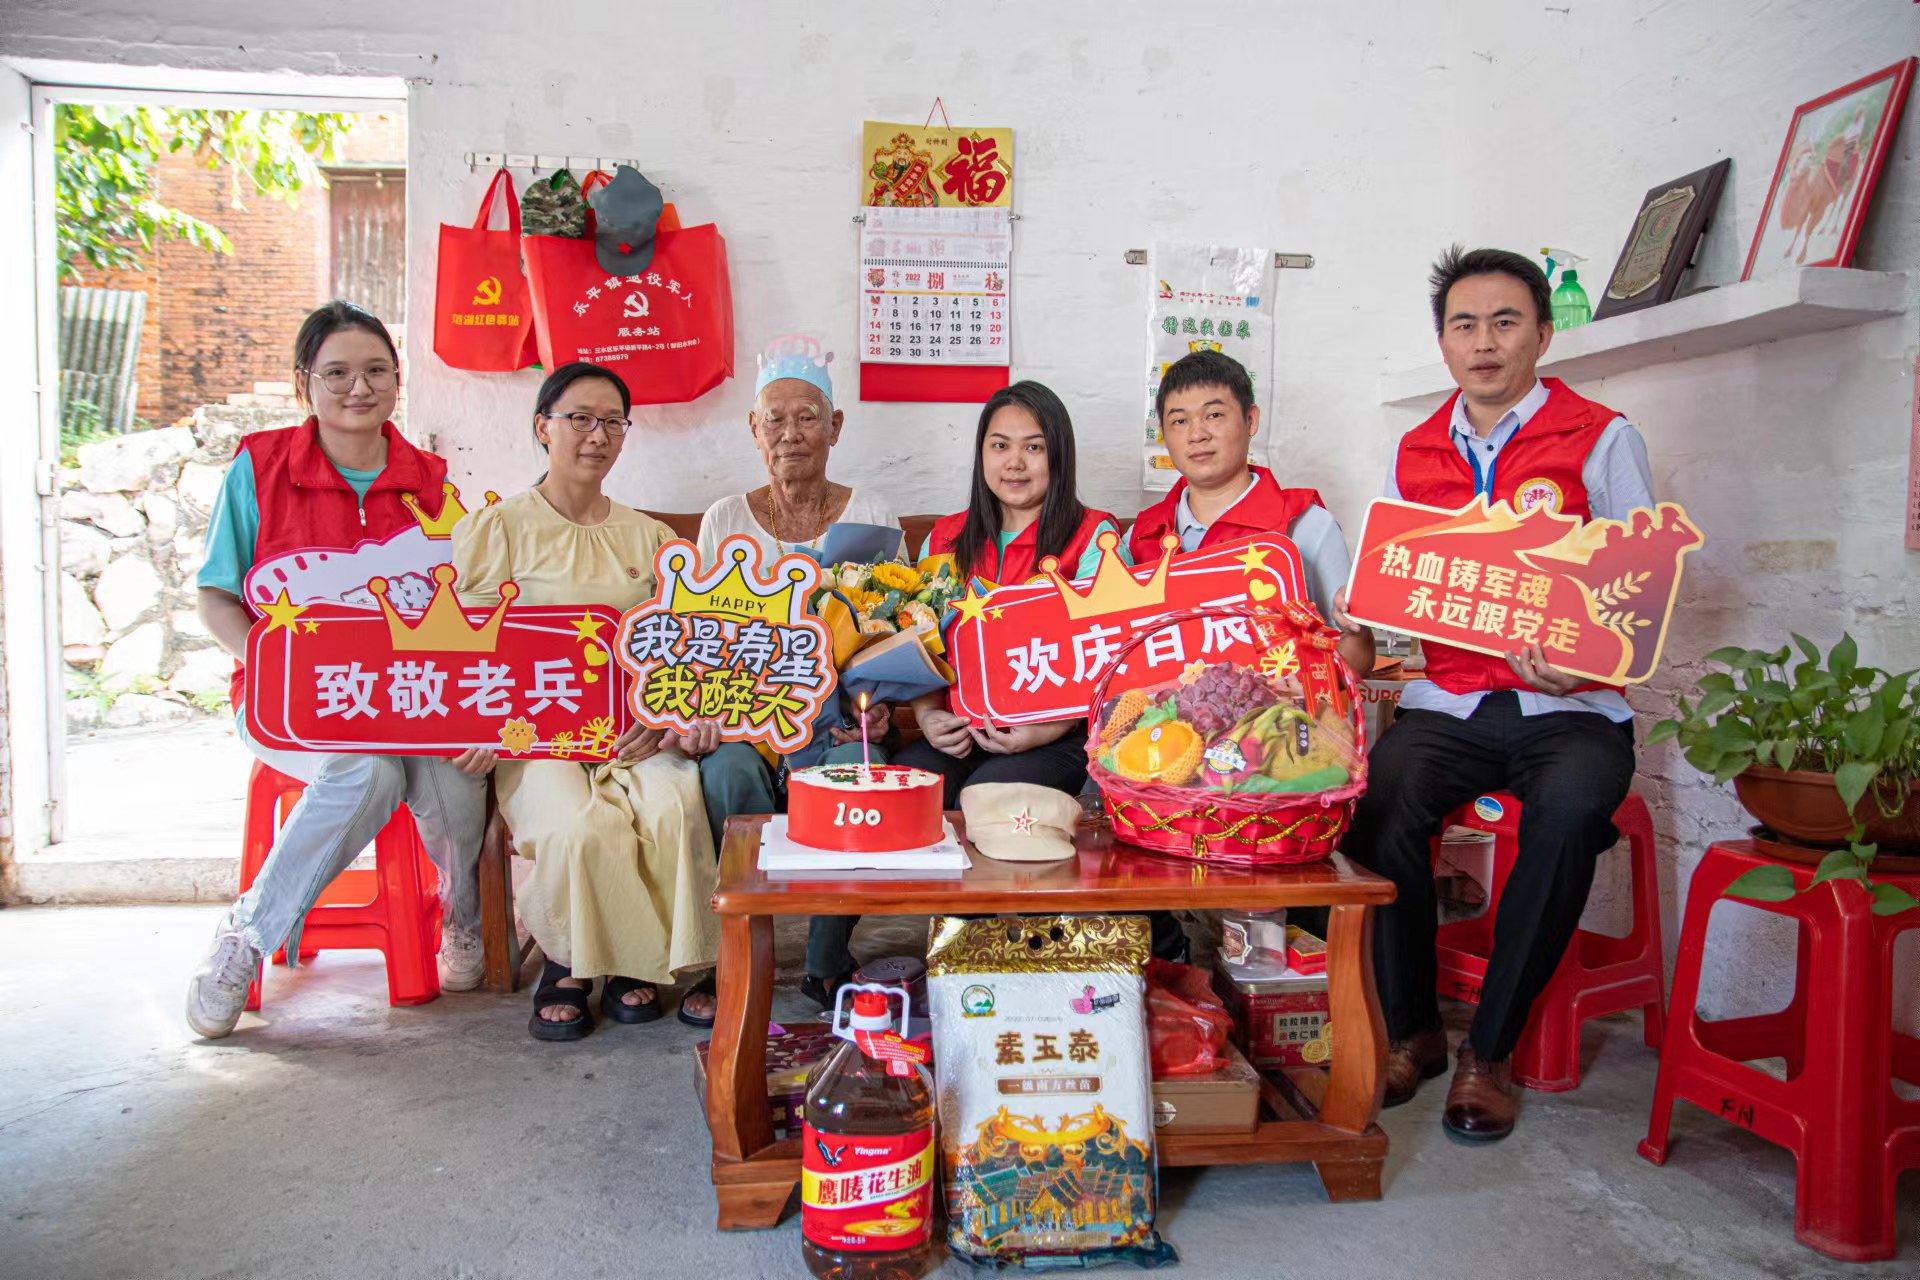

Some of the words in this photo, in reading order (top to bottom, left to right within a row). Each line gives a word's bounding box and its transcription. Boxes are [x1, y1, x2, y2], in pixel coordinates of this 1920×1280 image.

[943, 136, 1006, 202] 福
[928, 272, 944, 290] 捌
[893, 296, 897, 304] 1
[933, 297, 938, 305] 3
[973, 298, 978, 306] 5
[873, 308, 878, 316] 7
[893, 309, 898, 317] 8
[930, 310, 941, 318] 10
[971, 311, 981, 319] 12
[617, 326, 660, 337] 服务站
[870, 321, 881, 329] 14
[890, 322, 901, 330] 15
[930, 323, 941, 331] 17
[990, 324, 1001, 332] 20
[870, 334, 880, 342] 21
[890, 335, 901, 343] 22
[930, 336, 941, 344] 24
[870, 347, 881, 355] 28
[1380, 544, 1553, 609] 热血铸军魂
[709, 594, 767, 614] HAPPY
[1404, 586, 1582, 654] 永远跟党走
[630, 613, 822, 688] 我是寿星
[314, 657, 583, 720] 致敬老兵
[645, 666, 807, 739] 我醉大
[834, 802, 881, 827] 100
[995, 1028, 1100, 1066] 素玉泰
